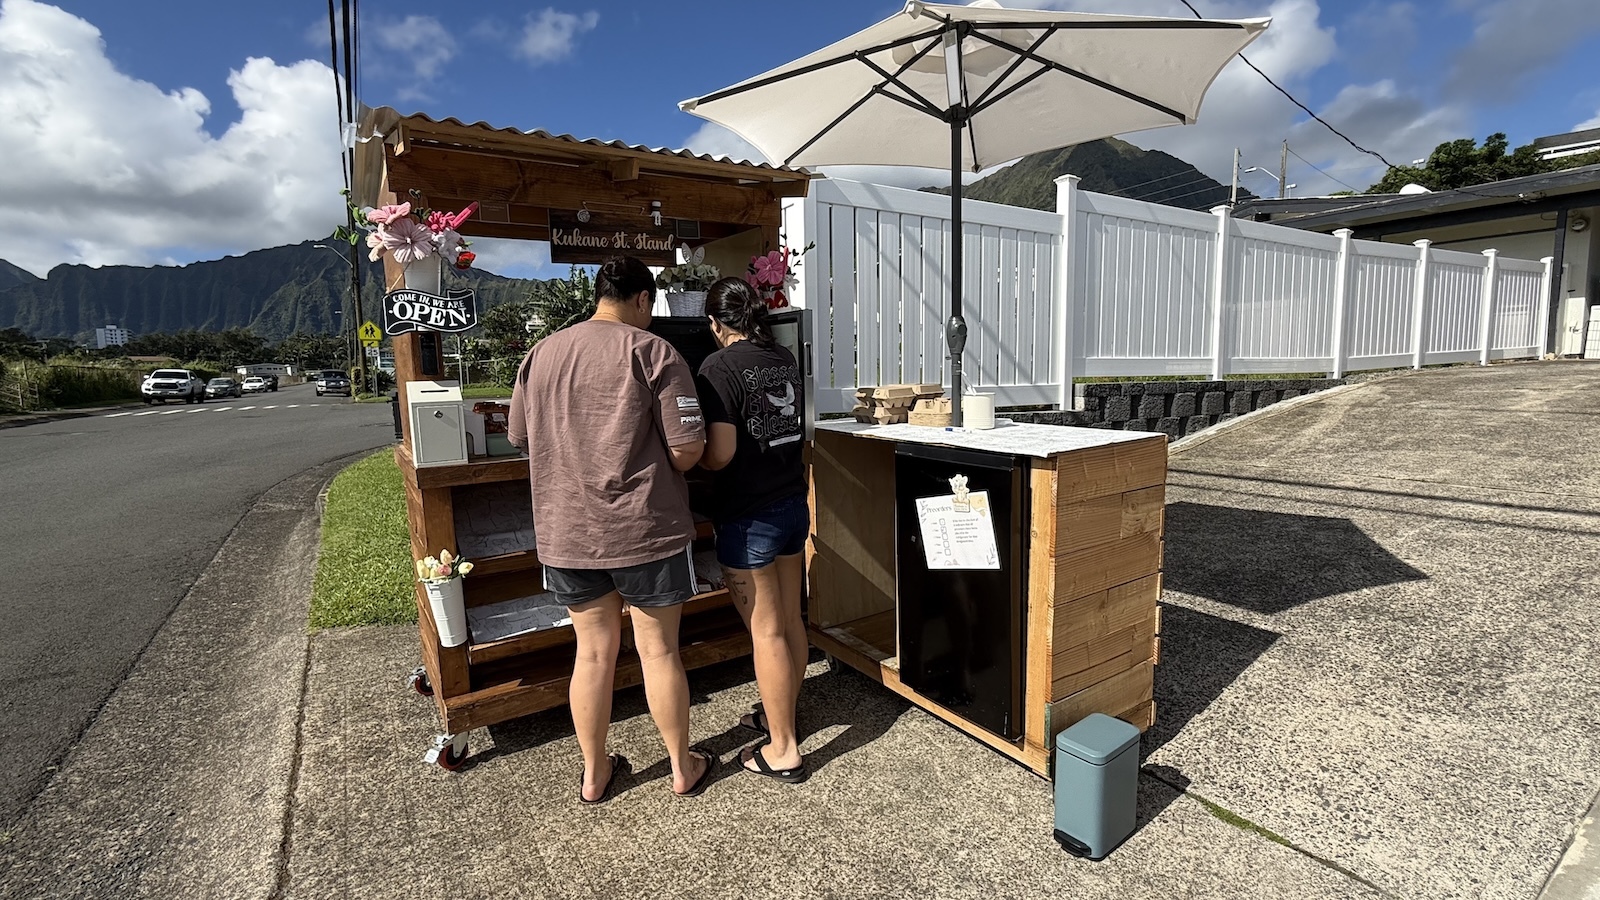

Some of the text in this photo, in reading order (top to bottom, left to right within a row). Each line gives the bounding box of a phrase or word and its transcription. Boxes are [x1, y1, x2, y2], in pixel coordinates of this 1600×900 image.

[552, 228, 675, 250] Kukane St. Stand
[393, 293, 416, 302] COME
[432, 298, 445, 308] WE
[447, 299, 465, 309] ARE
[393, 301, 467, 327] OPEN
[926, 505, 952, 513] Preorders
